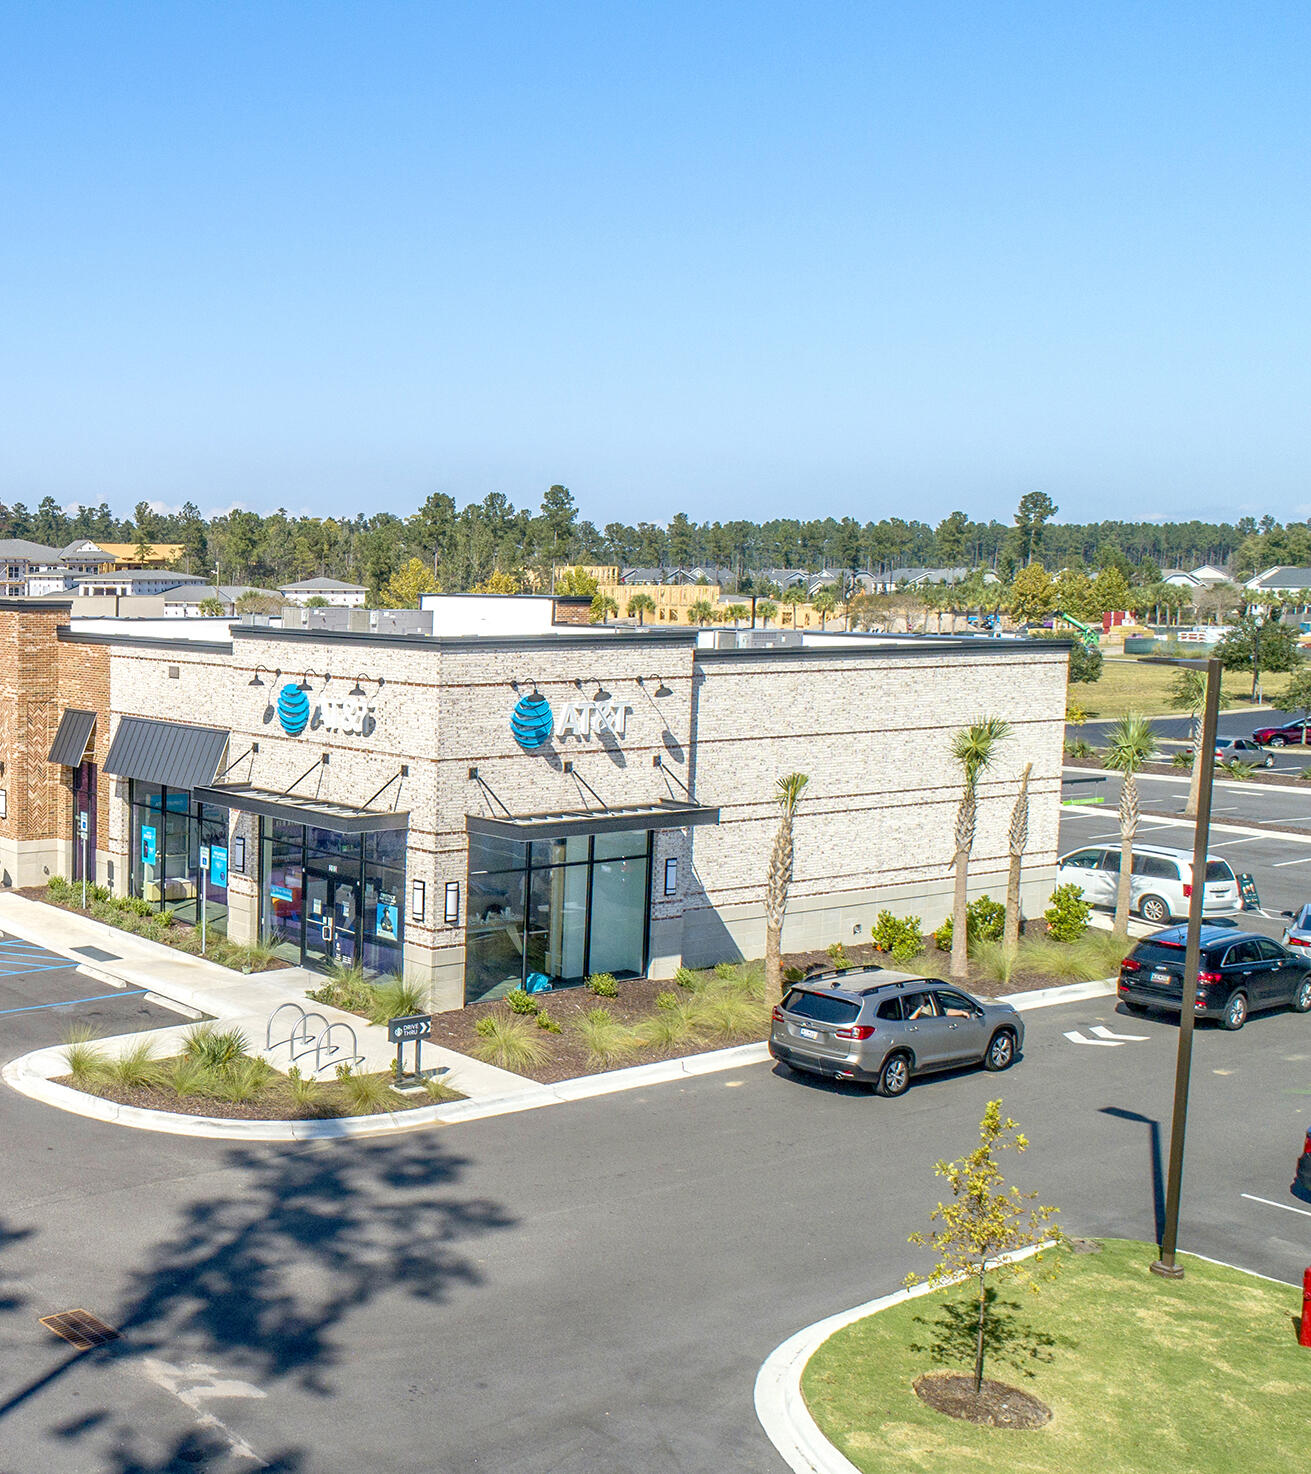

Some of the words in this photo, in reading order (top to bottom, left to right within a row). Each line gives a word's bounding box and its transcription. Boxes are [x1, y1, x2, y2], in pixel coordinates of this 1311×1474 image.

[319, 698, 374, 733] AT&T
[557, 700, 632, 736] AT&T
[402, 1023, 419, 1031] DRIVE
[403, 1029, 418, 1037] THRU
